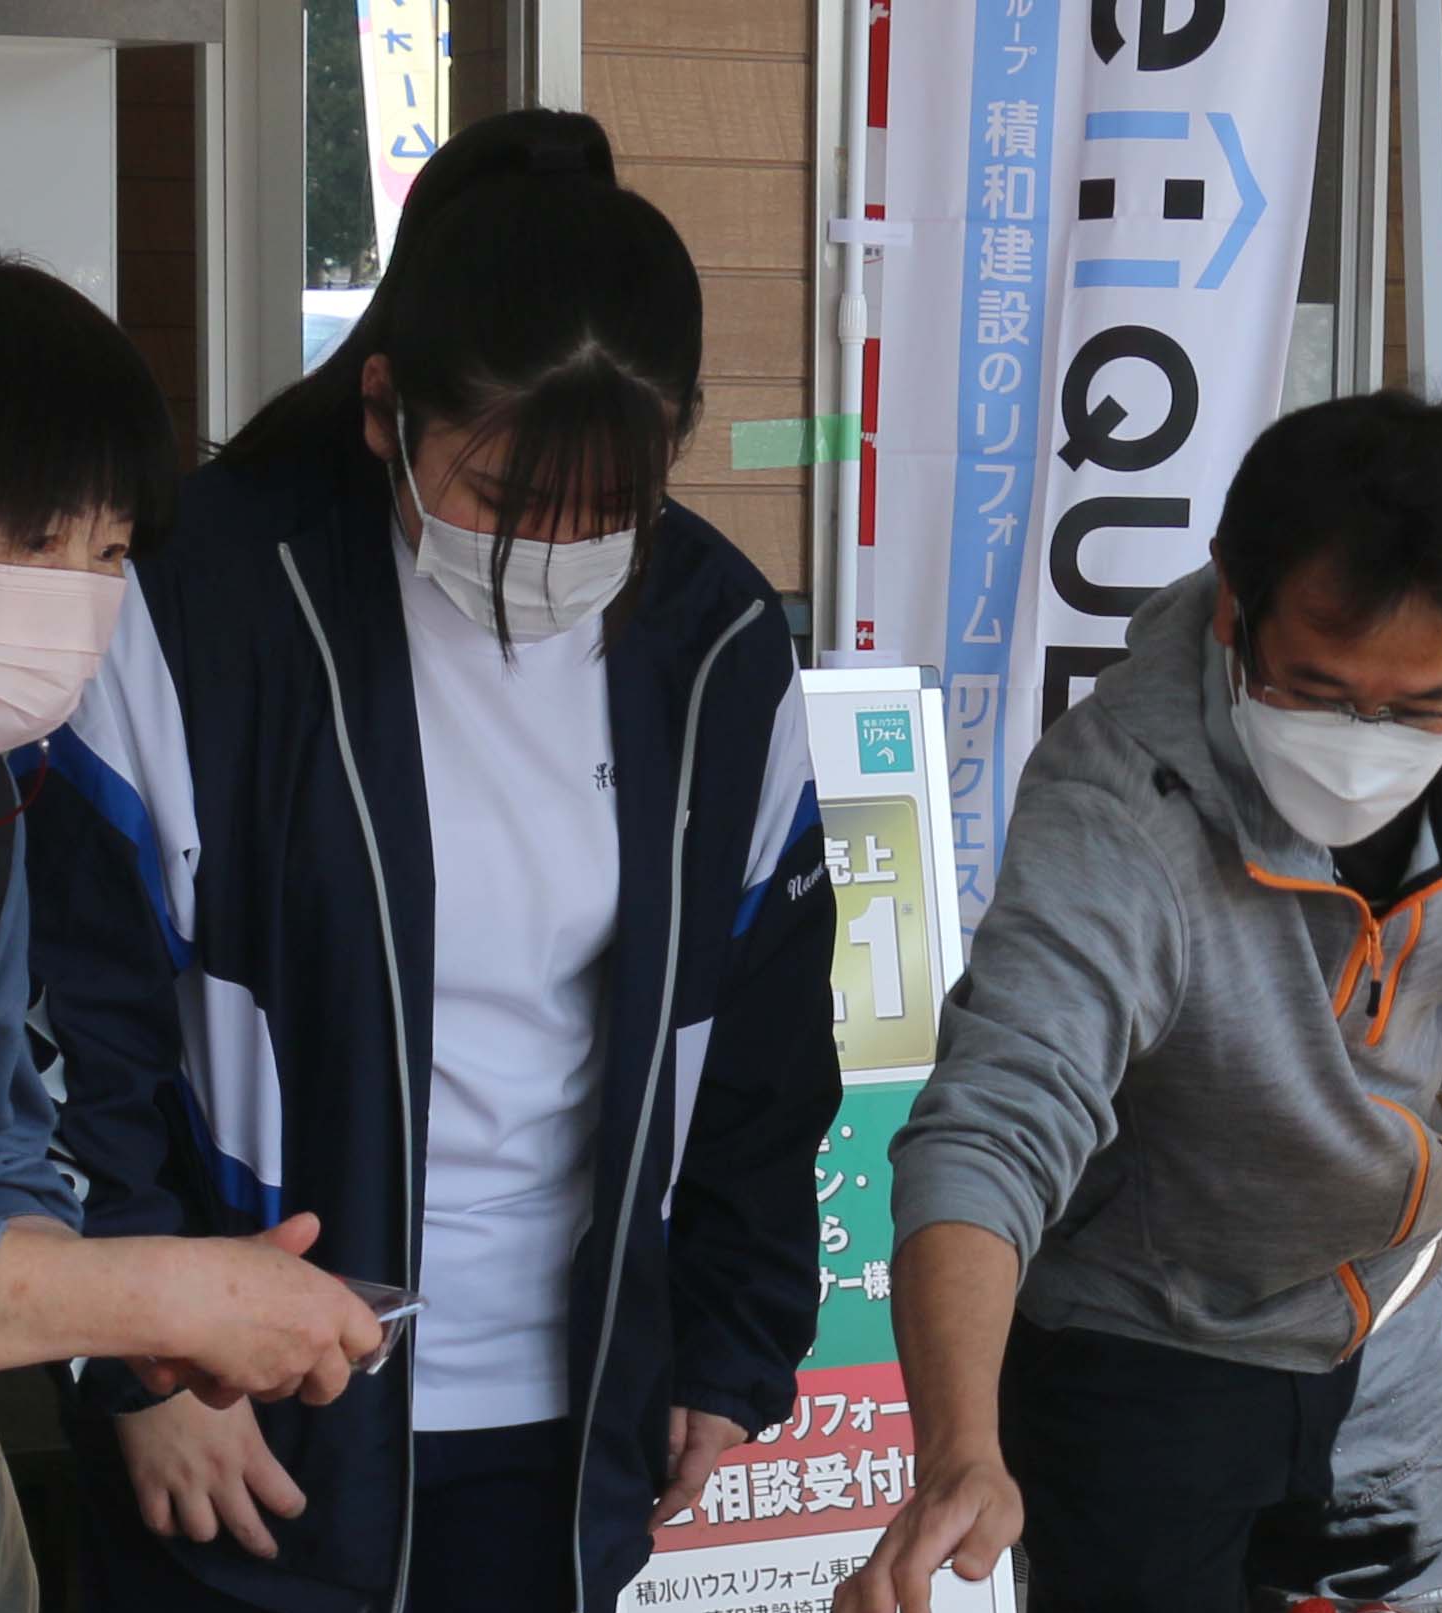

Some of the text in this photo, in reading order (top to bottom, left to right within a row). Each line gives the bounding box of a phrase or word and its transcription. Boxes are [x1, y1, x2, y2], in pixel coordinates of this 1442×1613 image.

[962, 100, 1039, 645] 積和建設のリフォーム
[863, 727, 907, 746] リフォーム
[950, 686, 991, 935] リ・クエス
[635, 1555, 873, 1607] 積水ハウスリフォーム東日
